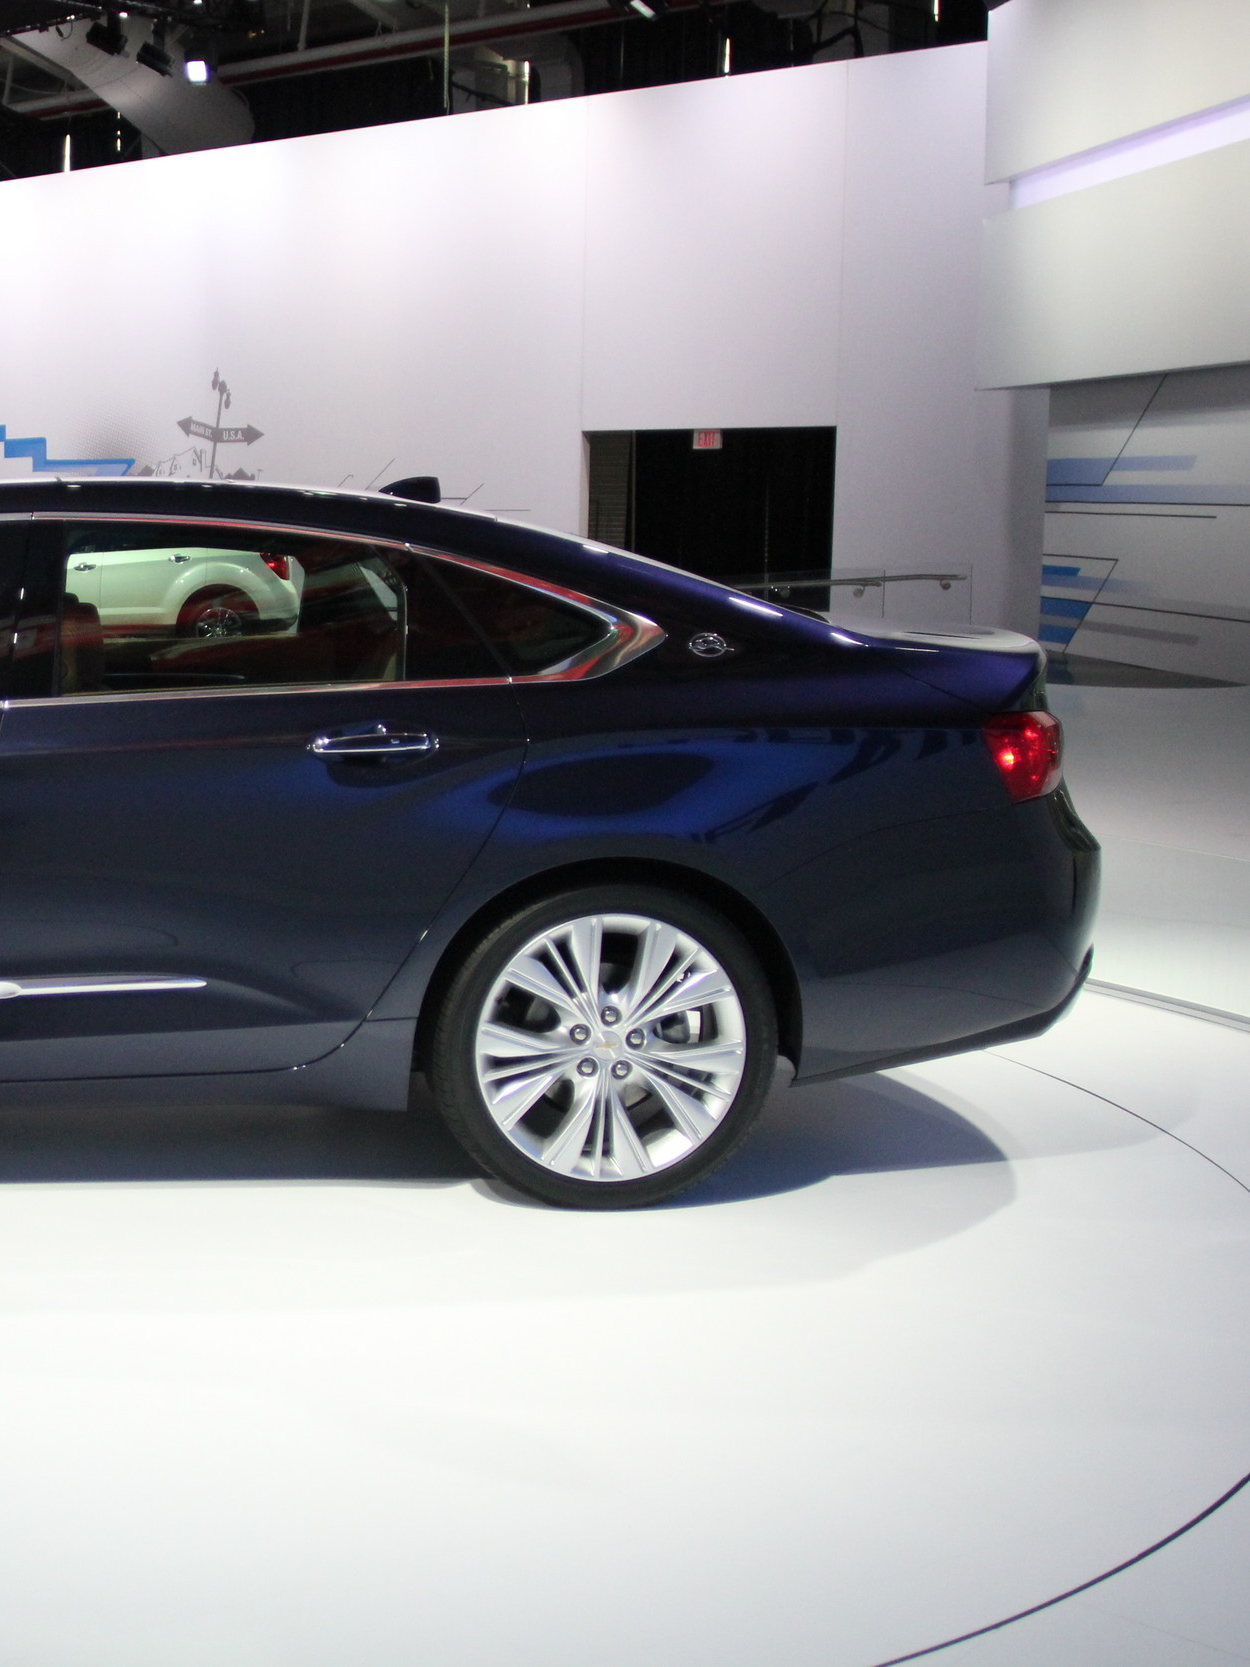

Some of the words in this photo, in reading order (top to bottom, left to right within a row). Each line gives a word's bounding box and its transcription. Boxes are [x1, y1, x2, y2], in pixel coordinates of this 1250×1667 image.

[190, 423, 205, 435] MAIN
[223, 430, 245, 440] U.S.A.
[698, 431, 718, 447] EXIT
